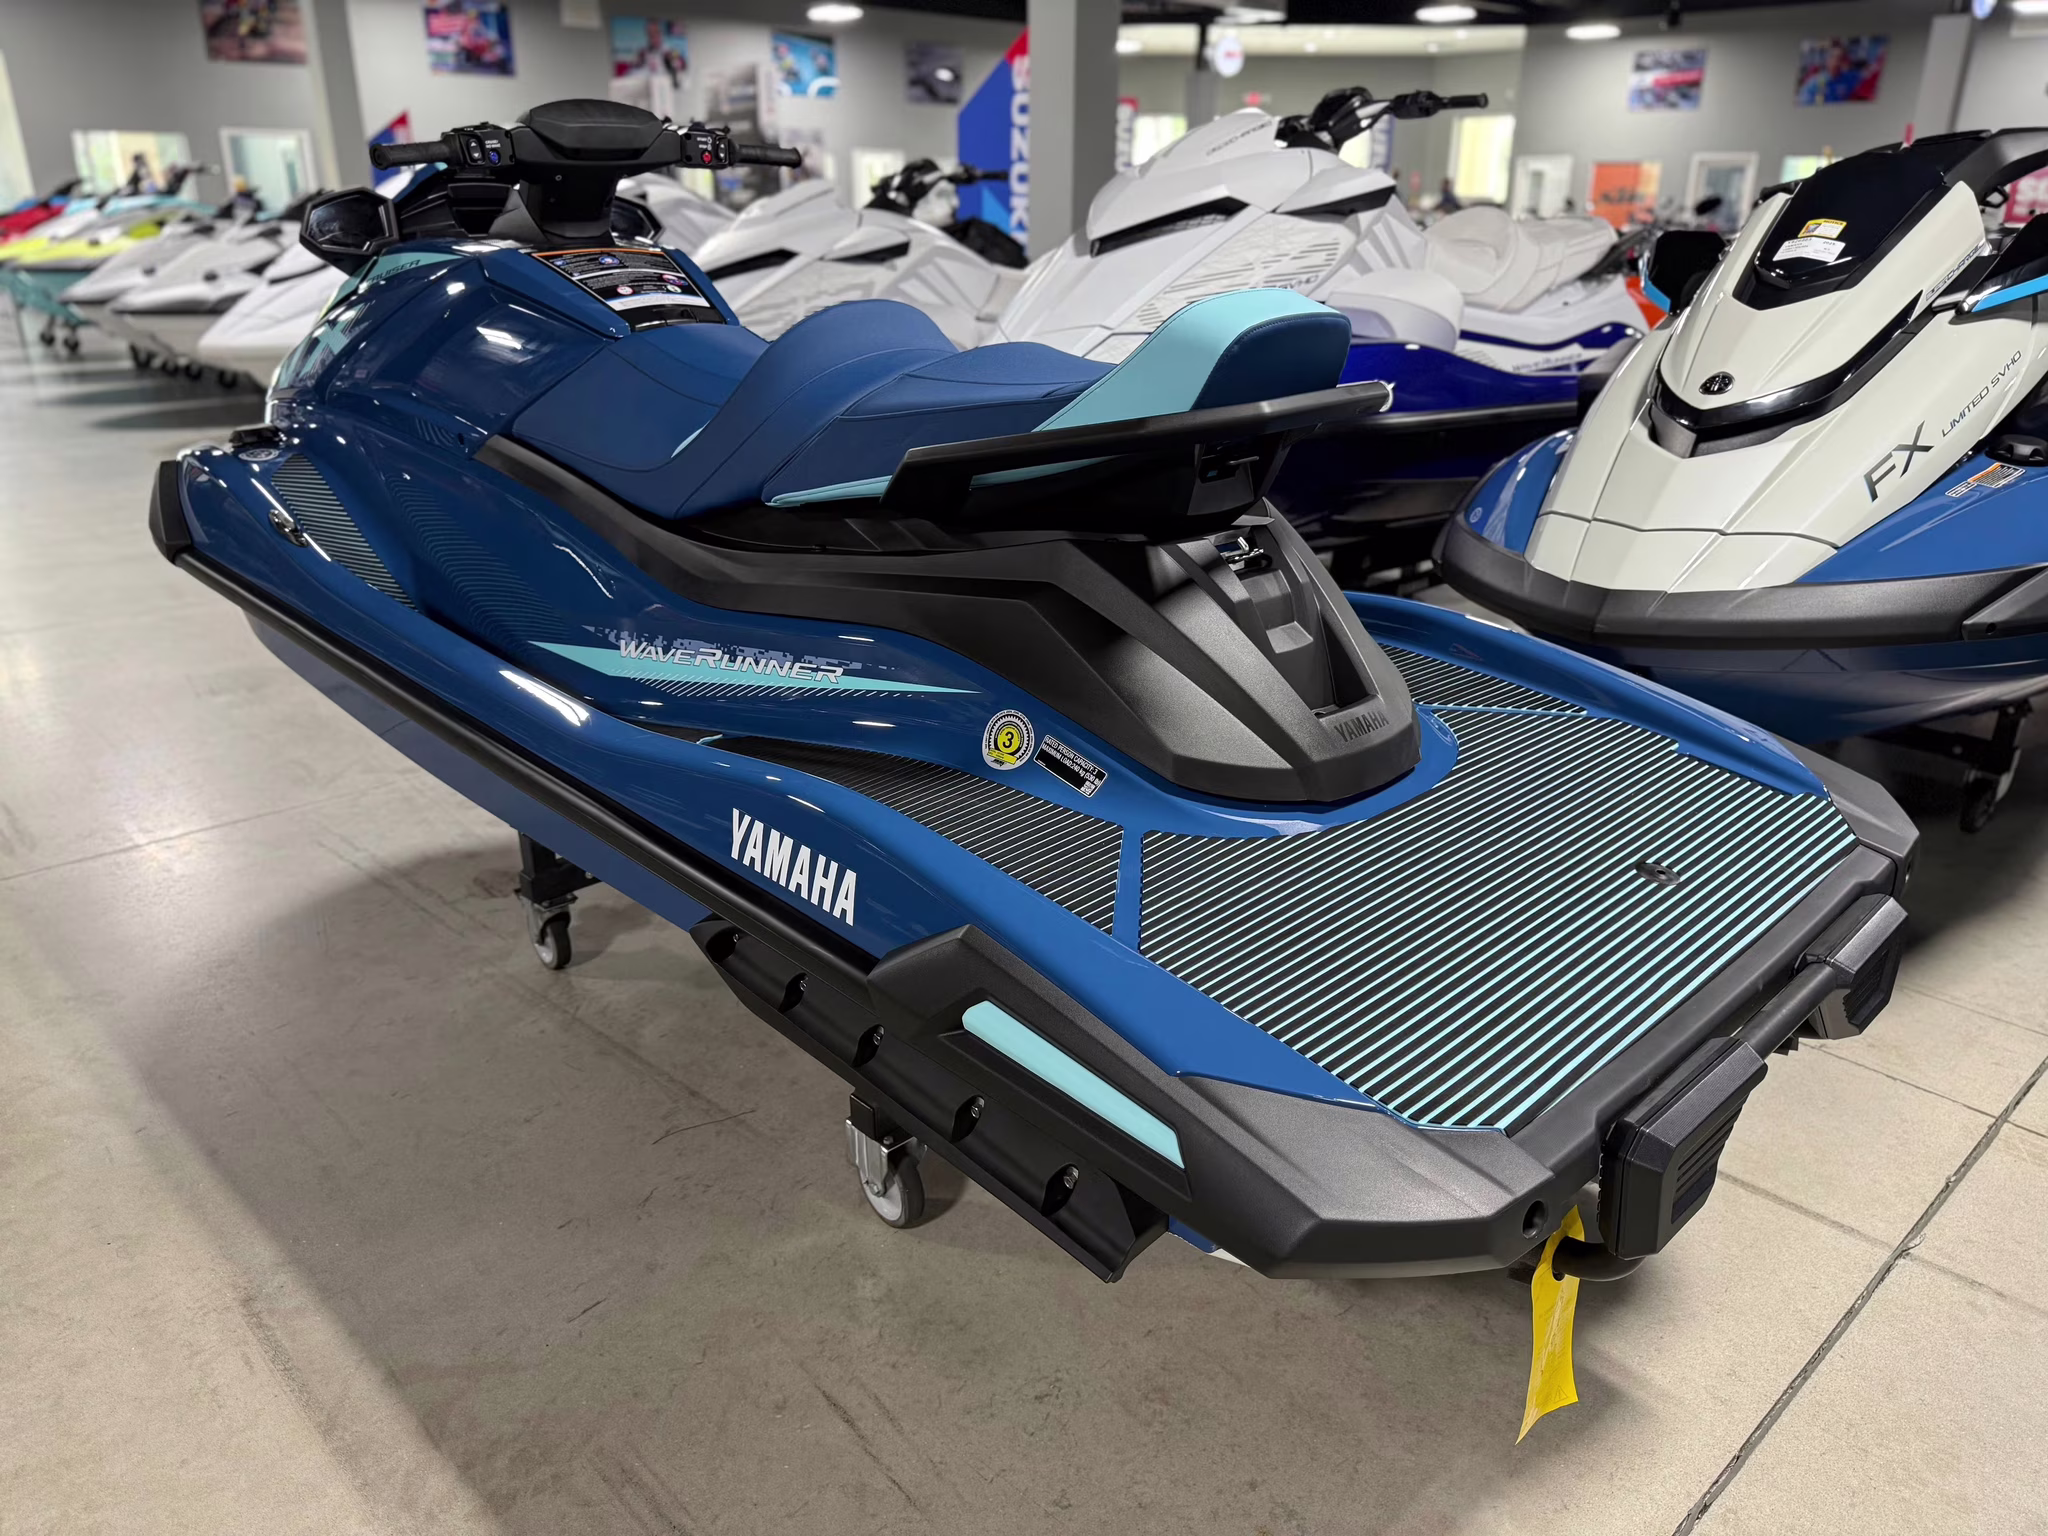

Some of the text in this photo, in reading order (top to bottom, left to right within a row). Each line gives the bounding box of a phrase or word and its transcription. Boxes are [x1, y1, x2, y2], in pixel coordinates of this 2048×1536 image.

[1941, 385, 1990, 438] LIMITED
[1990, 350, 2022, 388] SVHO
[1863, 420, 1935, 503] FX
[1002, 731, 1014, 749] 3
[1334, 711, 1390, 743] YAMAHA
[1041, 743, 1062, 761] MAXIMUM
[1079, 767, 1086, 778] kg
[1045, 735, 1059, 749] RATED
[1058, 743, 1075, 760] PERSON
[731, 807, 857, 927] YAMAHA
